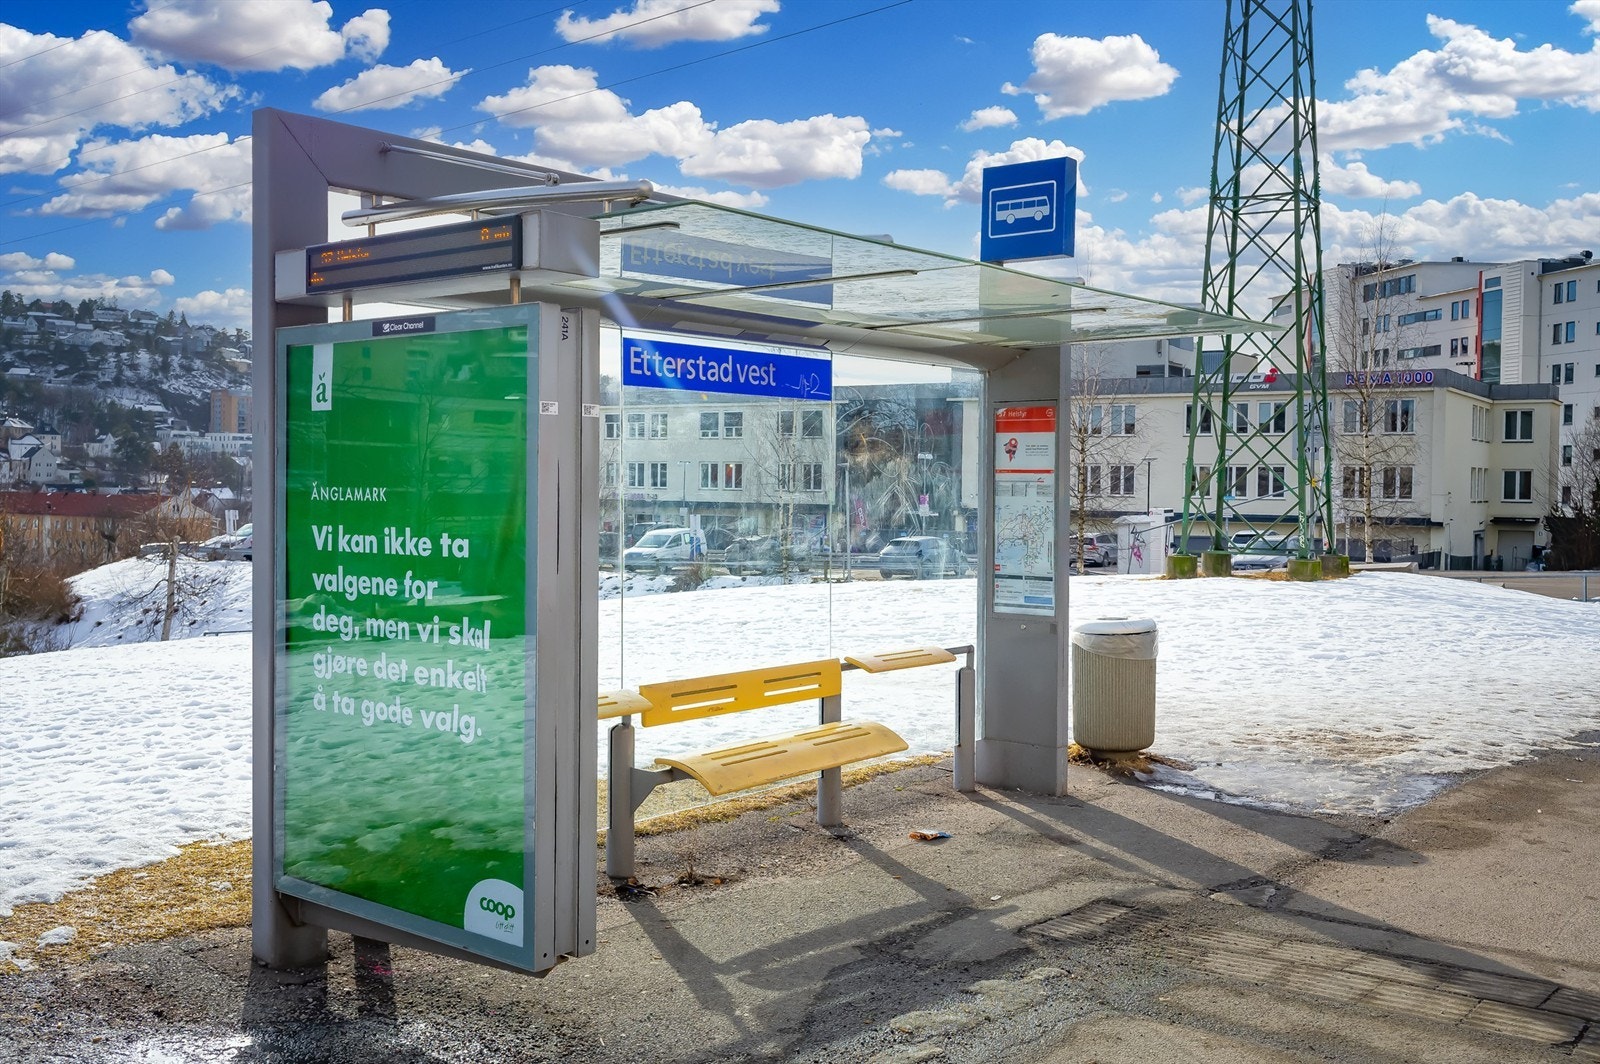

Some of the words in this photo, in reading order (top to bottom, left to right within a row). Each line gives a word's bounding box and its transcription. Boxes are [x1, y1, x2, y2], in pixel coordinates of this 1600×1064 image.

[390, 323, 403, 331] Clear
[403, 321, 424, 330] Channel
[561, 315, 569, 341] 241A
[629, 346, 733, 383] Etterstad
[736, 363, 777, 387] vest
[1396, 370, 1434, 384] 1000
[312, 525, 333, 551] Vi
[338, 525, 378, 554] kan
[384, 527, 432, 557] ikke
[440, 533, 470, 559] ta
[312, 565, 398, 601] valgene
[404, 570, 438, 600] for
[312, 604, 360, 642] deg,
[366, 617, 410, 641] men
[417, 615, 440, 644] vi
[448, 616, 491, 650] skal
[313, 646, 368, 680] gjøre
[373, 652, 408, 683] det
[414, 659, 487, 694] enkelt
[313, 684, 326, 711] å
[332, 691, 355, 716] ta
[361, 696, 413, 727] gode
[420, 703, 482, 743] valg.
[480, 896, 515, 921] coop
